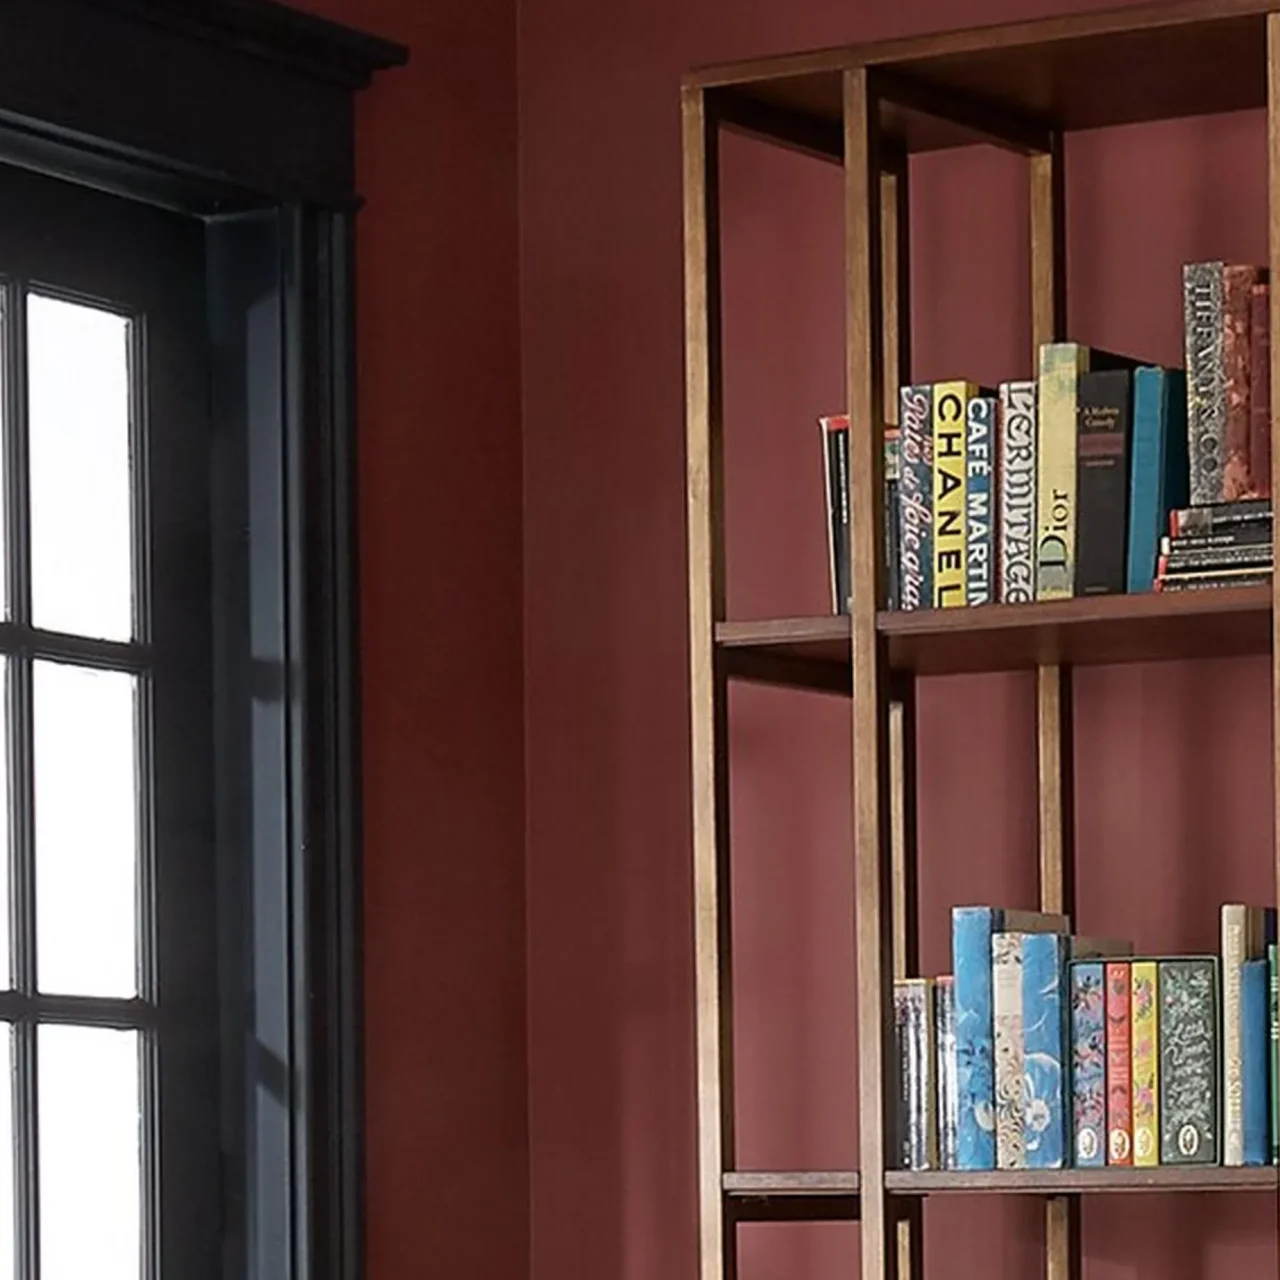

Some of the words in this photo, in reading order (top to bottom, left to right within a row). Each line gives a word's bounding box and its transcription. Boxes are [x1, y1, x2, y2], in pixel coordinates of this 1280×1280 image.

[967, 399, 991, 477] CAFÉ
[901, 493, 932, 550] foie
[938, 394, 962, 608] CHANEL
[1040, 489, 1068, 572] Dior
